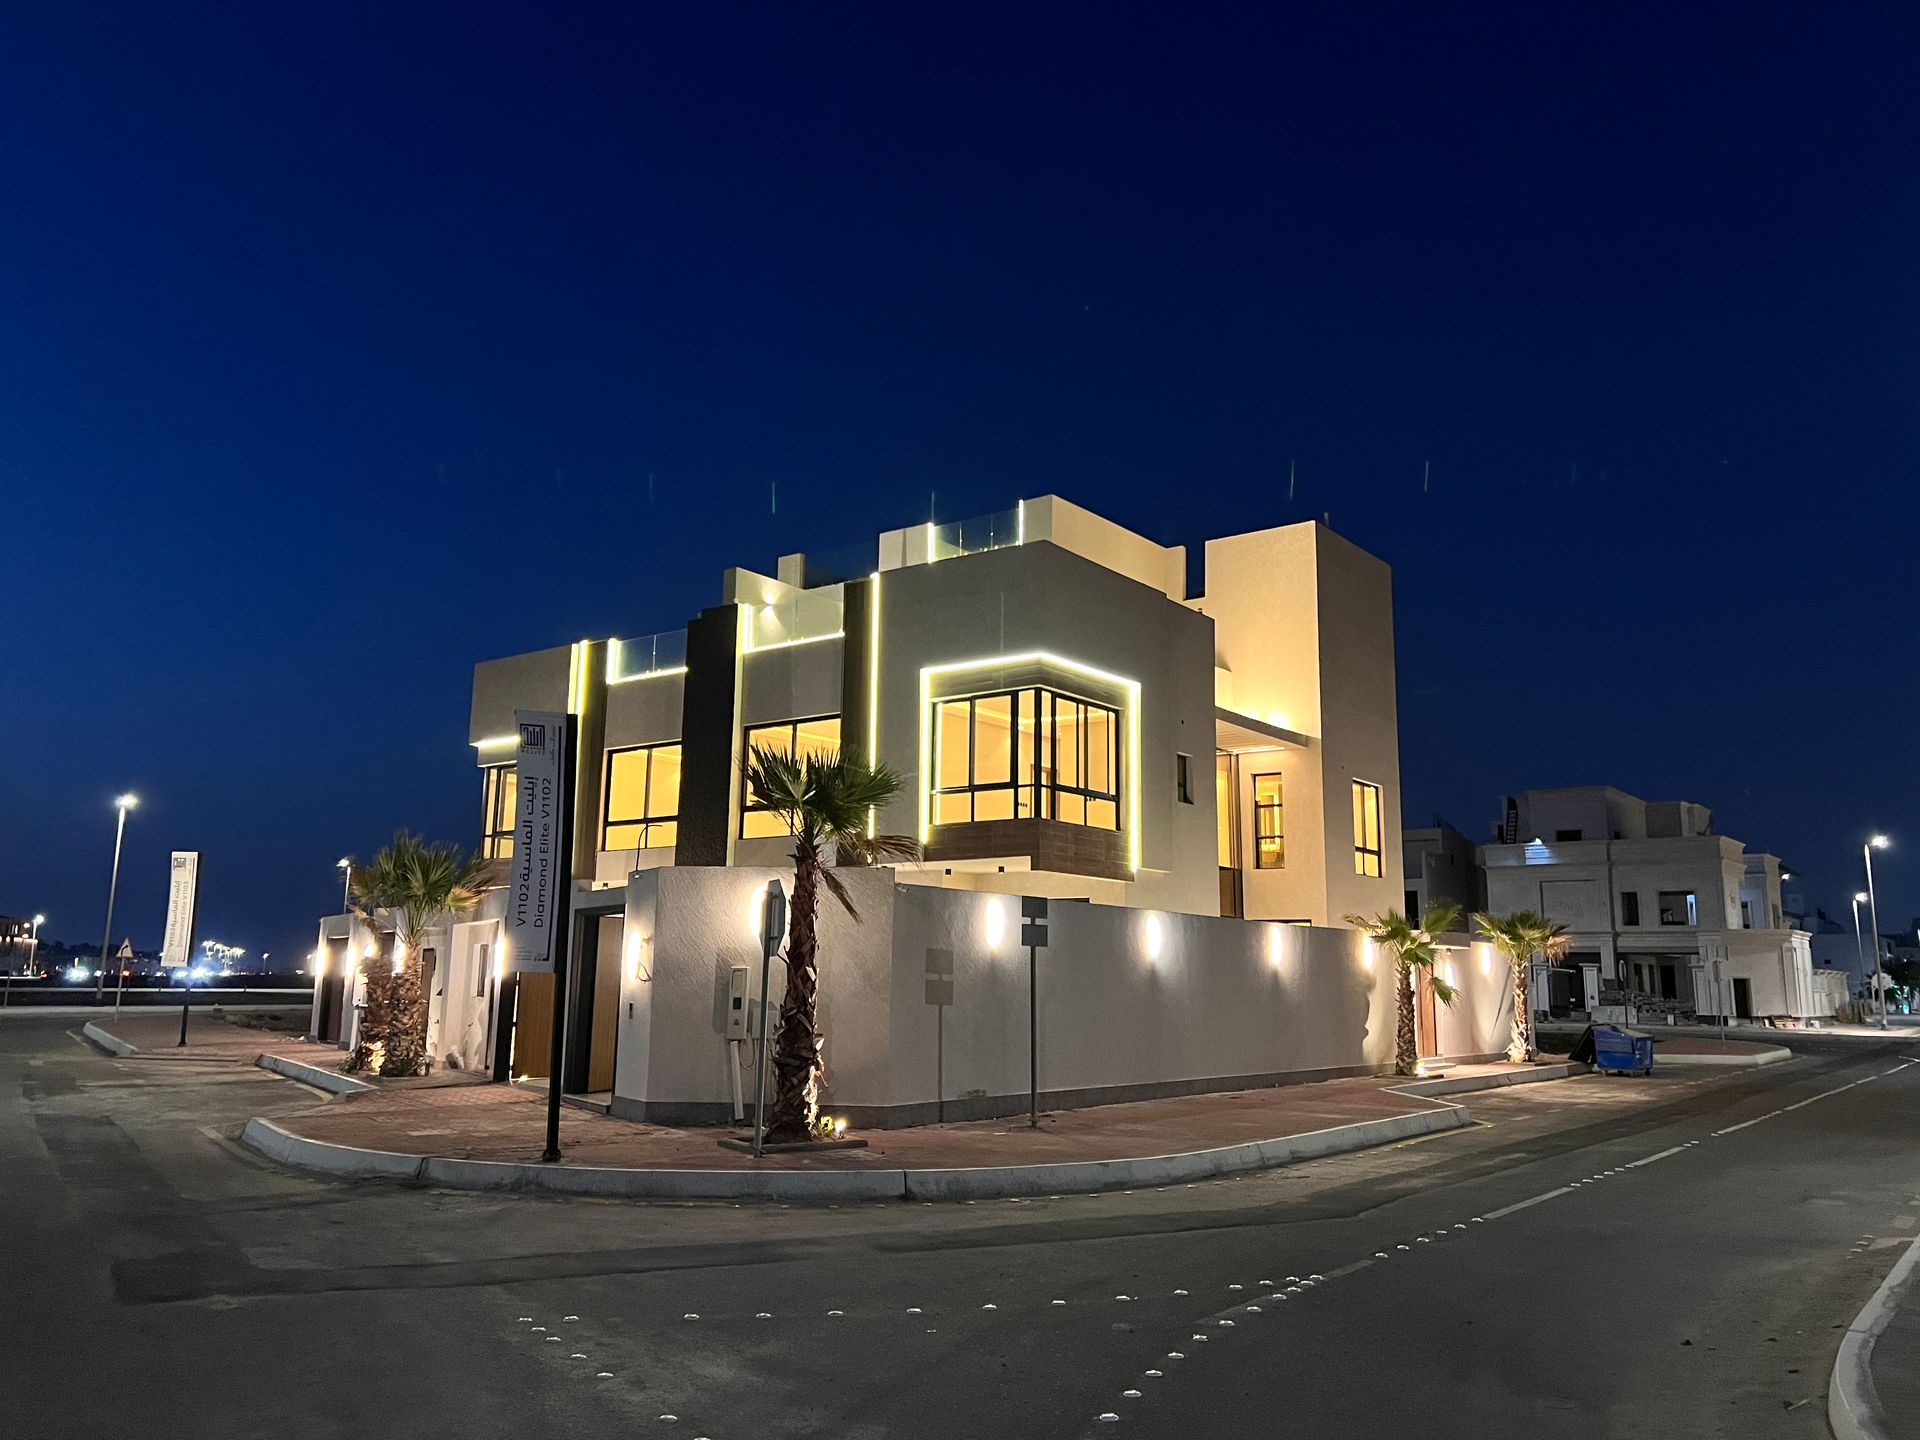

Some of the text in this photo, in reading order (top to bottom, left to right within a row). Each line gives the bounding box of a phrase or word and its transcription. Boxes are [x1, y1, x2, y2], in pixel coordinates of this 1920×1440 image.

[524, 776, 538, 815] إيليت
[534, 778, 552, 927] Diamond Elite V1102
